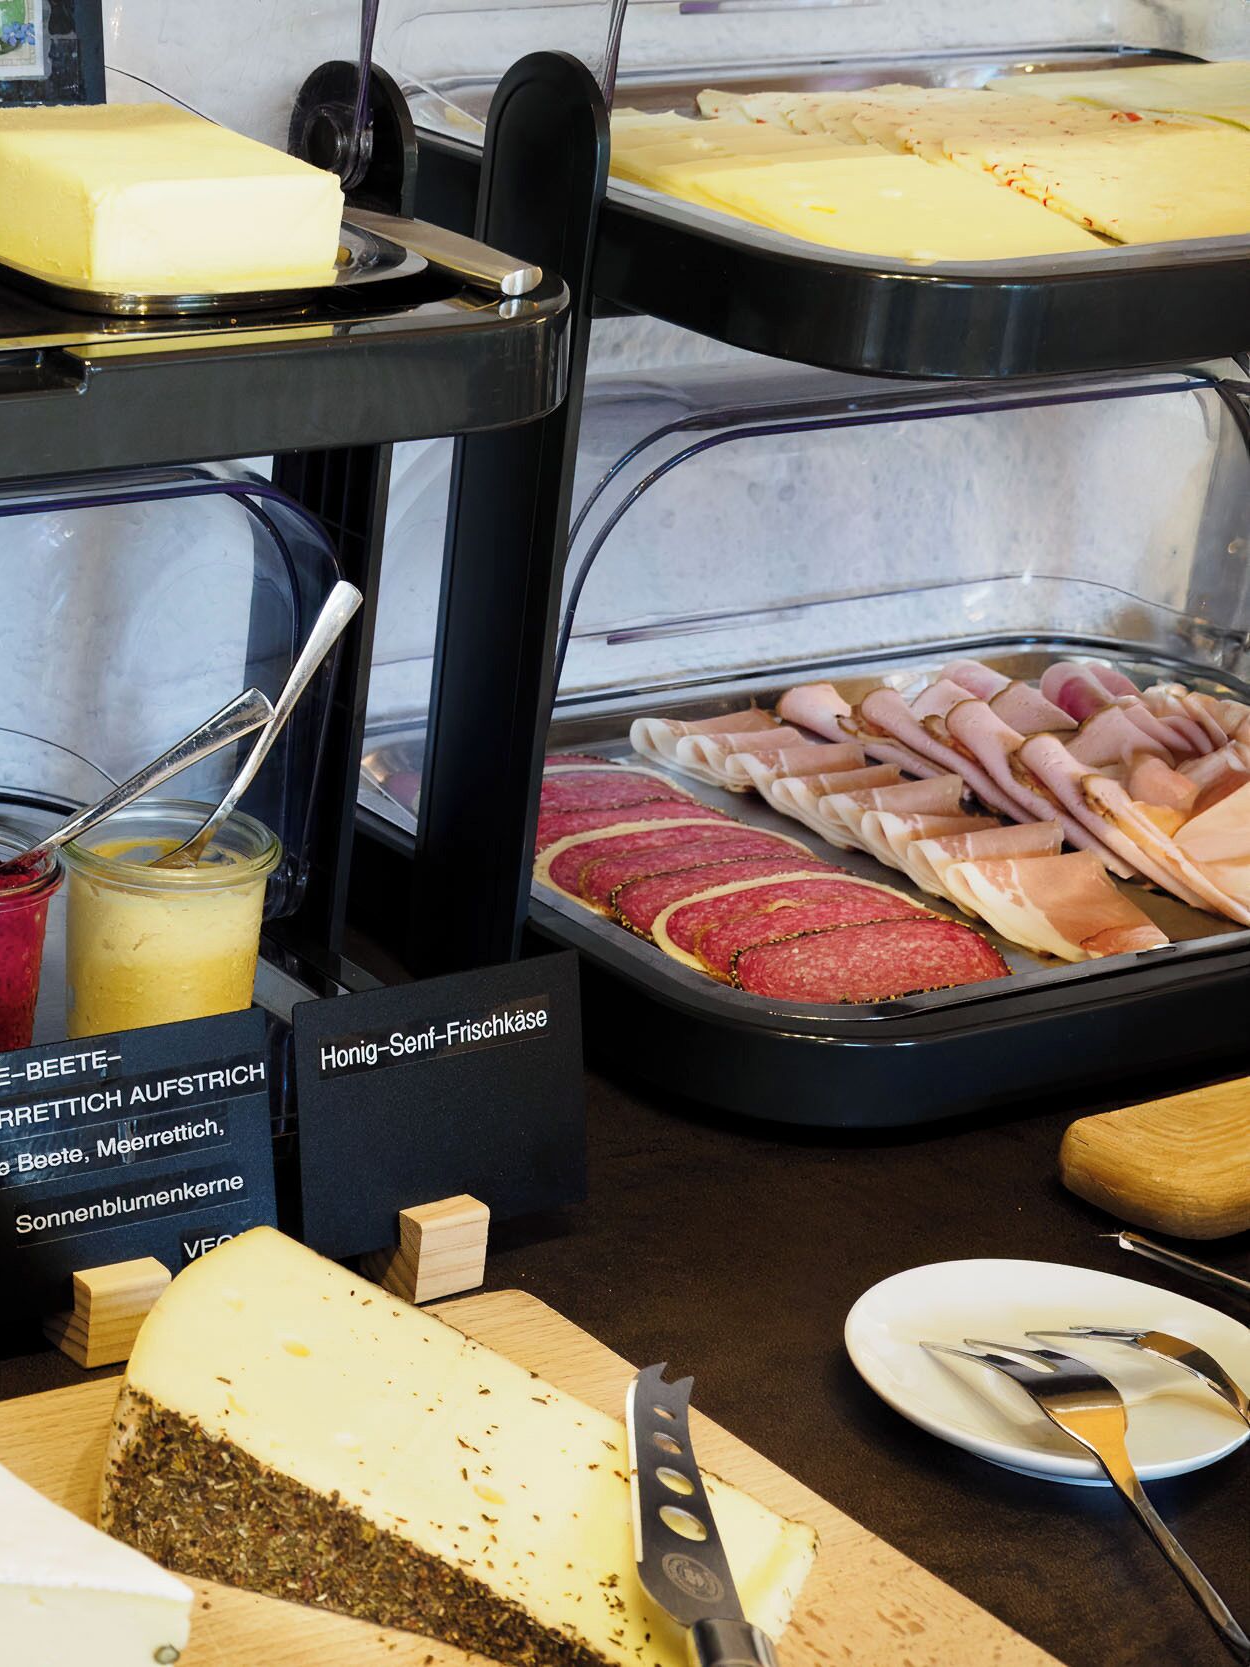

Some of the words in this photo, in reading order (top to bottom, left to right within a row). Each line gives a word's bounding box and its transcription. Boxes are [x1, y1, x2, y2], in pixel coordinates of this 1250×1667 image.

[129, 1062, 266, 1106] AUFSTRICH
[17, 1148, 90, 1173] Beete,
[96, 1117, 225, 1158] Meerrettich,
[15, 1174, 244, 1234] Sonnenblumenkerne
